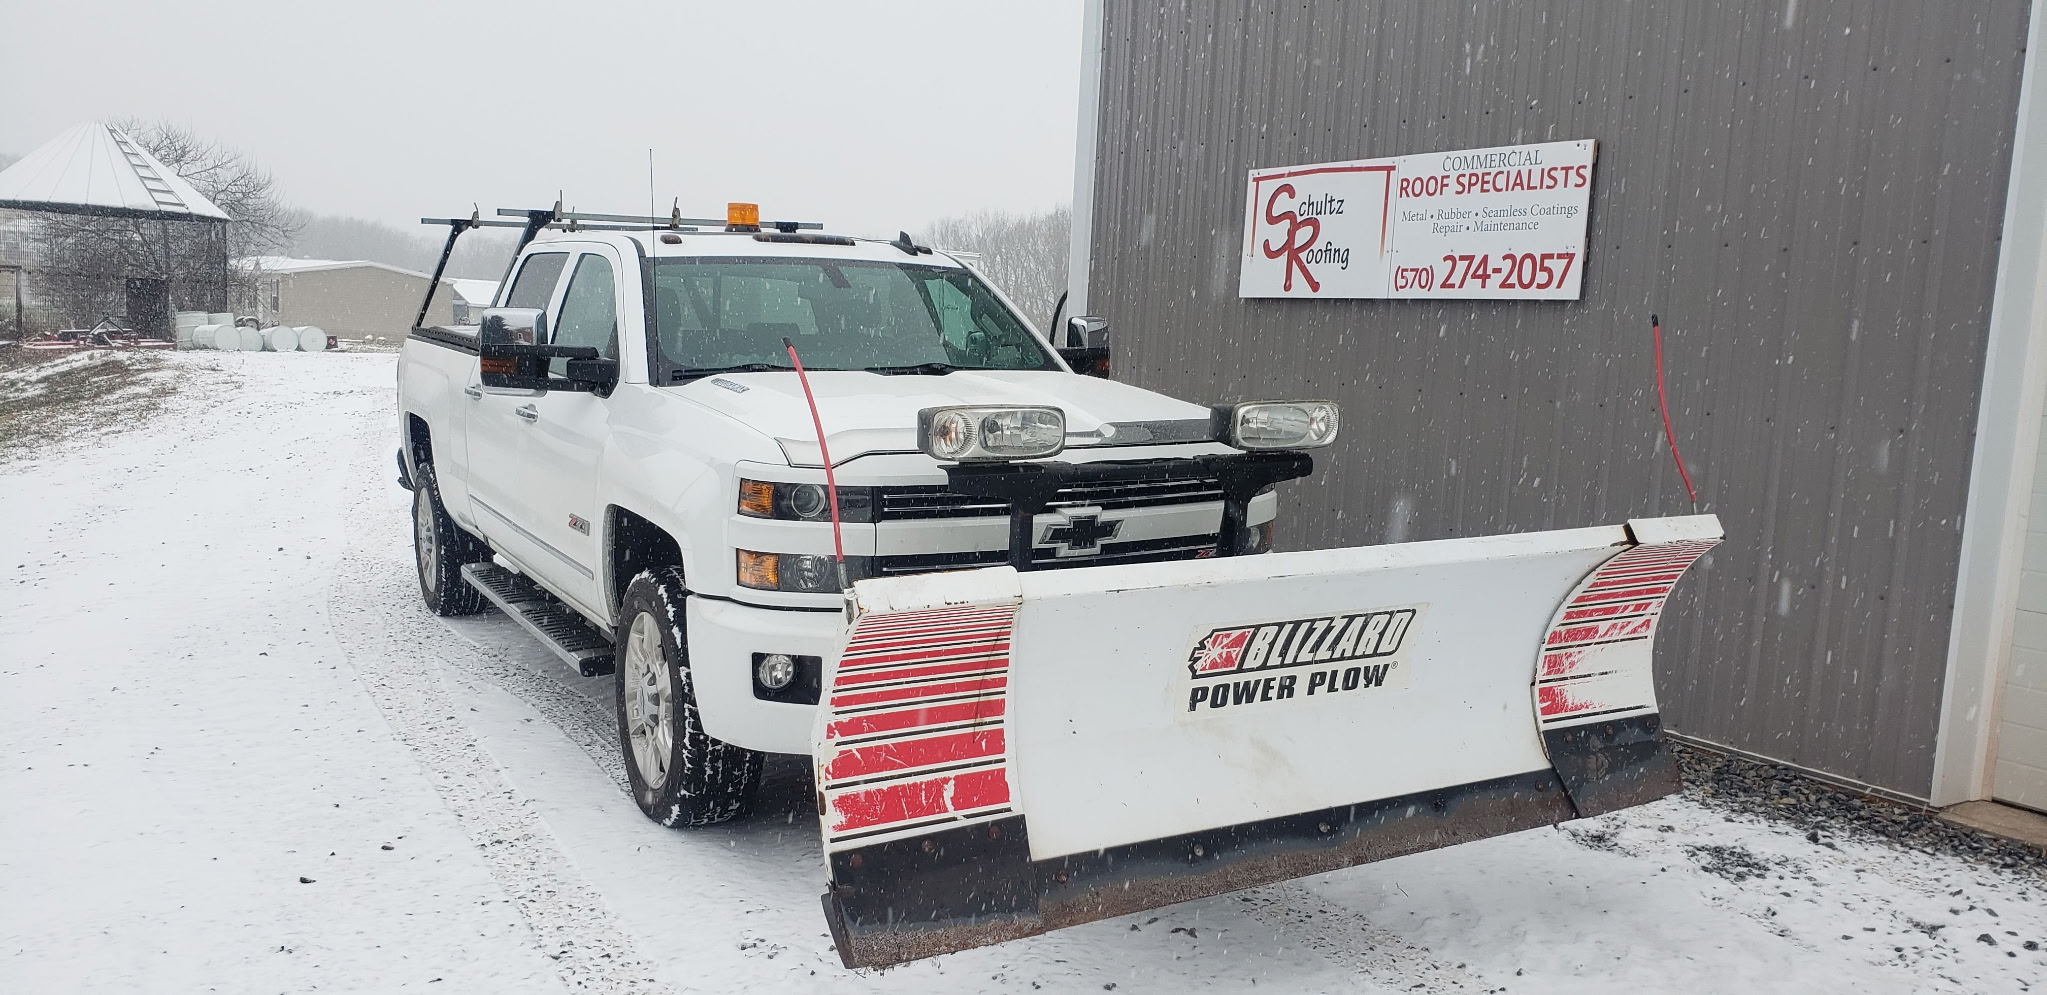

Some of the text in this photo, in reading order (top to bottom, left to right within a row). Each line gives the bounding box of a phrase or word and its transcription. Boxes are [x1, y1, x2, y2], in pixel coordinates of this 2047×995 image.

[1442, 150, 1543, 172] COMMERCIAL
[1399, 164, 1588, 199] ROOF SPECIALISTS
[1263, 184, 1345, 260] Schultz
[1401, 203, 1579, 222] Metal Rubber Seamless Coatings
[1431, 220, 1539, 237] Repair Maintenance
[1284, 217, 1350, 293] Roofing
[1394, 252, 1576, 292] (570) 274-2057
[1242, 611, 1415, 670] BLIZZARD
[1188, 663, 1391, 712] POWER PLOW
